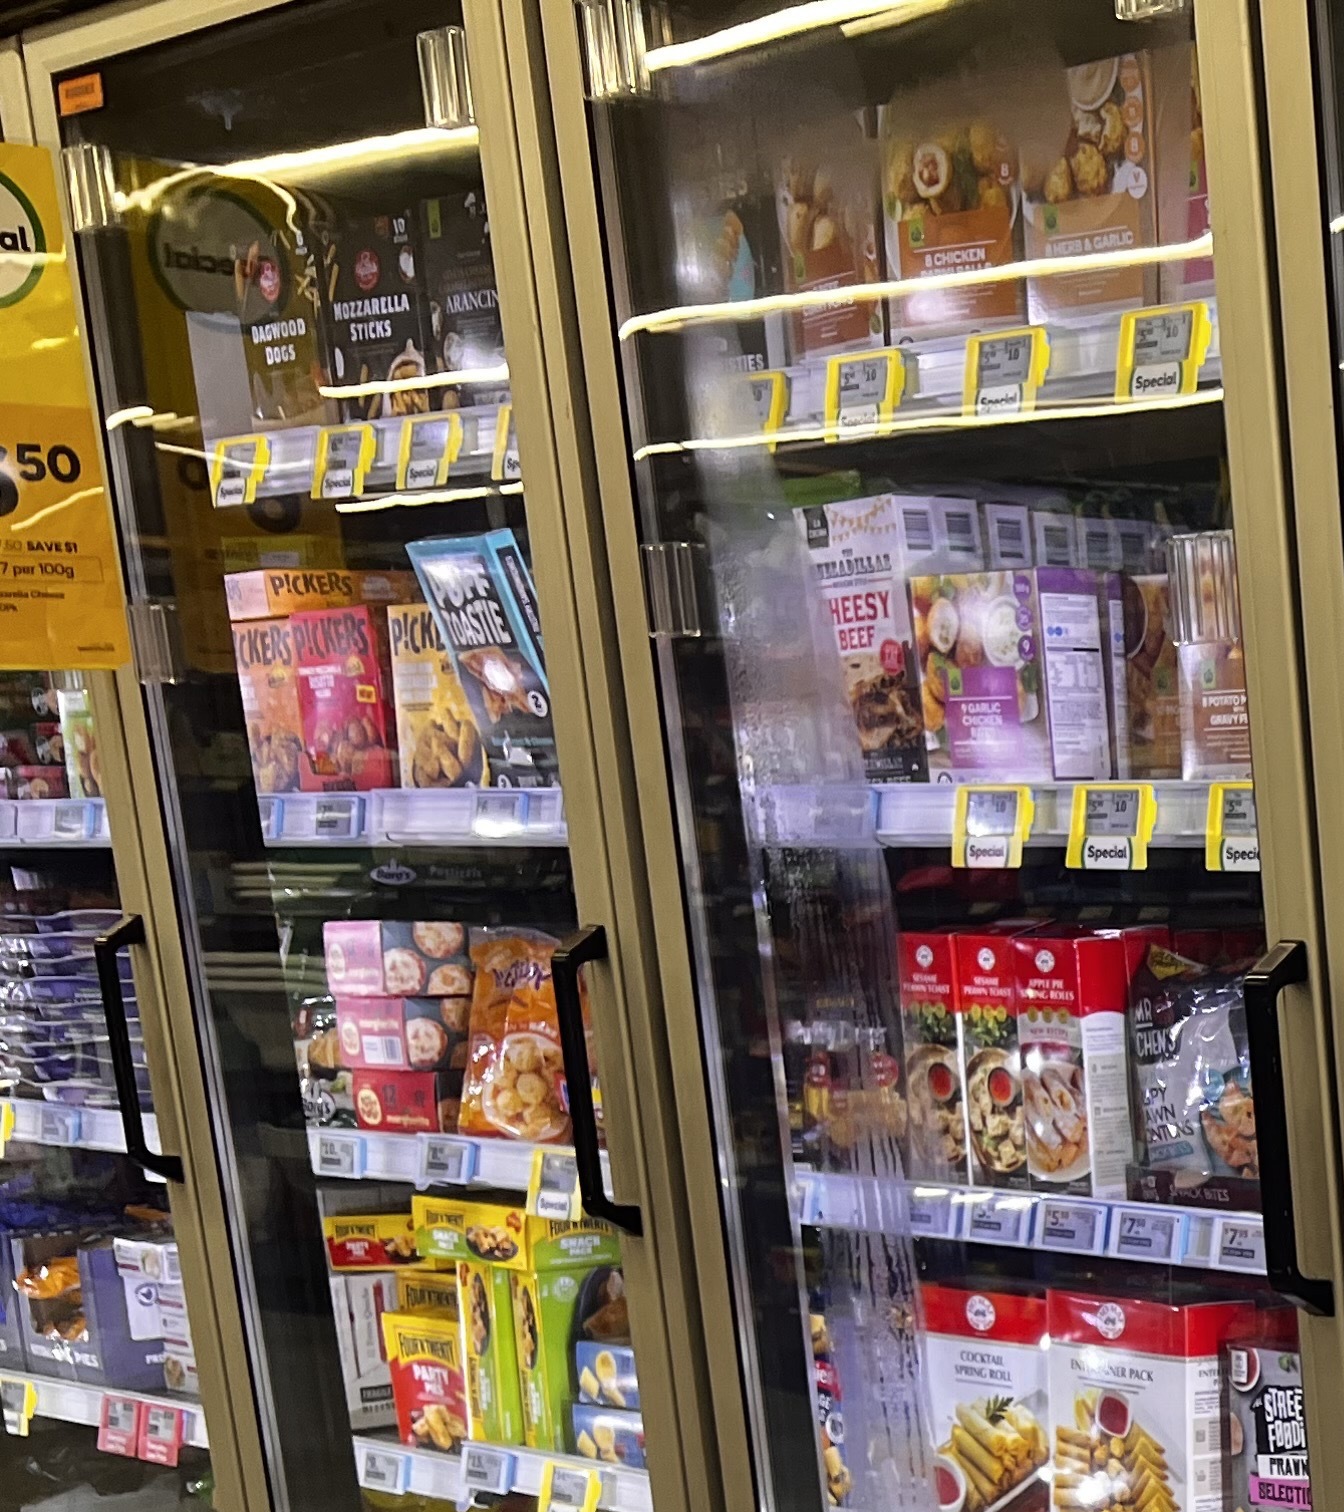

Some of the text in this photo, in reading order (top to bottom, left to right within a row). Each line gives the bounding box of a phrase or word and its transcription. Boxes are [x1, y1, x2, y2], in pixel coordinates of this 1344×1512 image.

[1096, 230, 1135, 250] GARLIC
[935, 247, 986, 267] CHICKEN
[334, 294, 410, 321] MOZZARELLA
[252, 318, 306, 344] DAGWOOD
[350, 320, 391, 341] STICKS
[265, 344, 296, 365] DOGS
[1134, 369, 1178, 393] Special
[441, 600, 511, 646] TOASTIE
[838, 624, 876, 651] BEEF
[968, 702, 1001, 714] GARLIC
[968, 844, 1005, 860] Special
[1087, 845, 1128, 862] Special
[412, 1364, 450, 1383] PARTY
[1128, 1366, 1154, 1382] PACK
